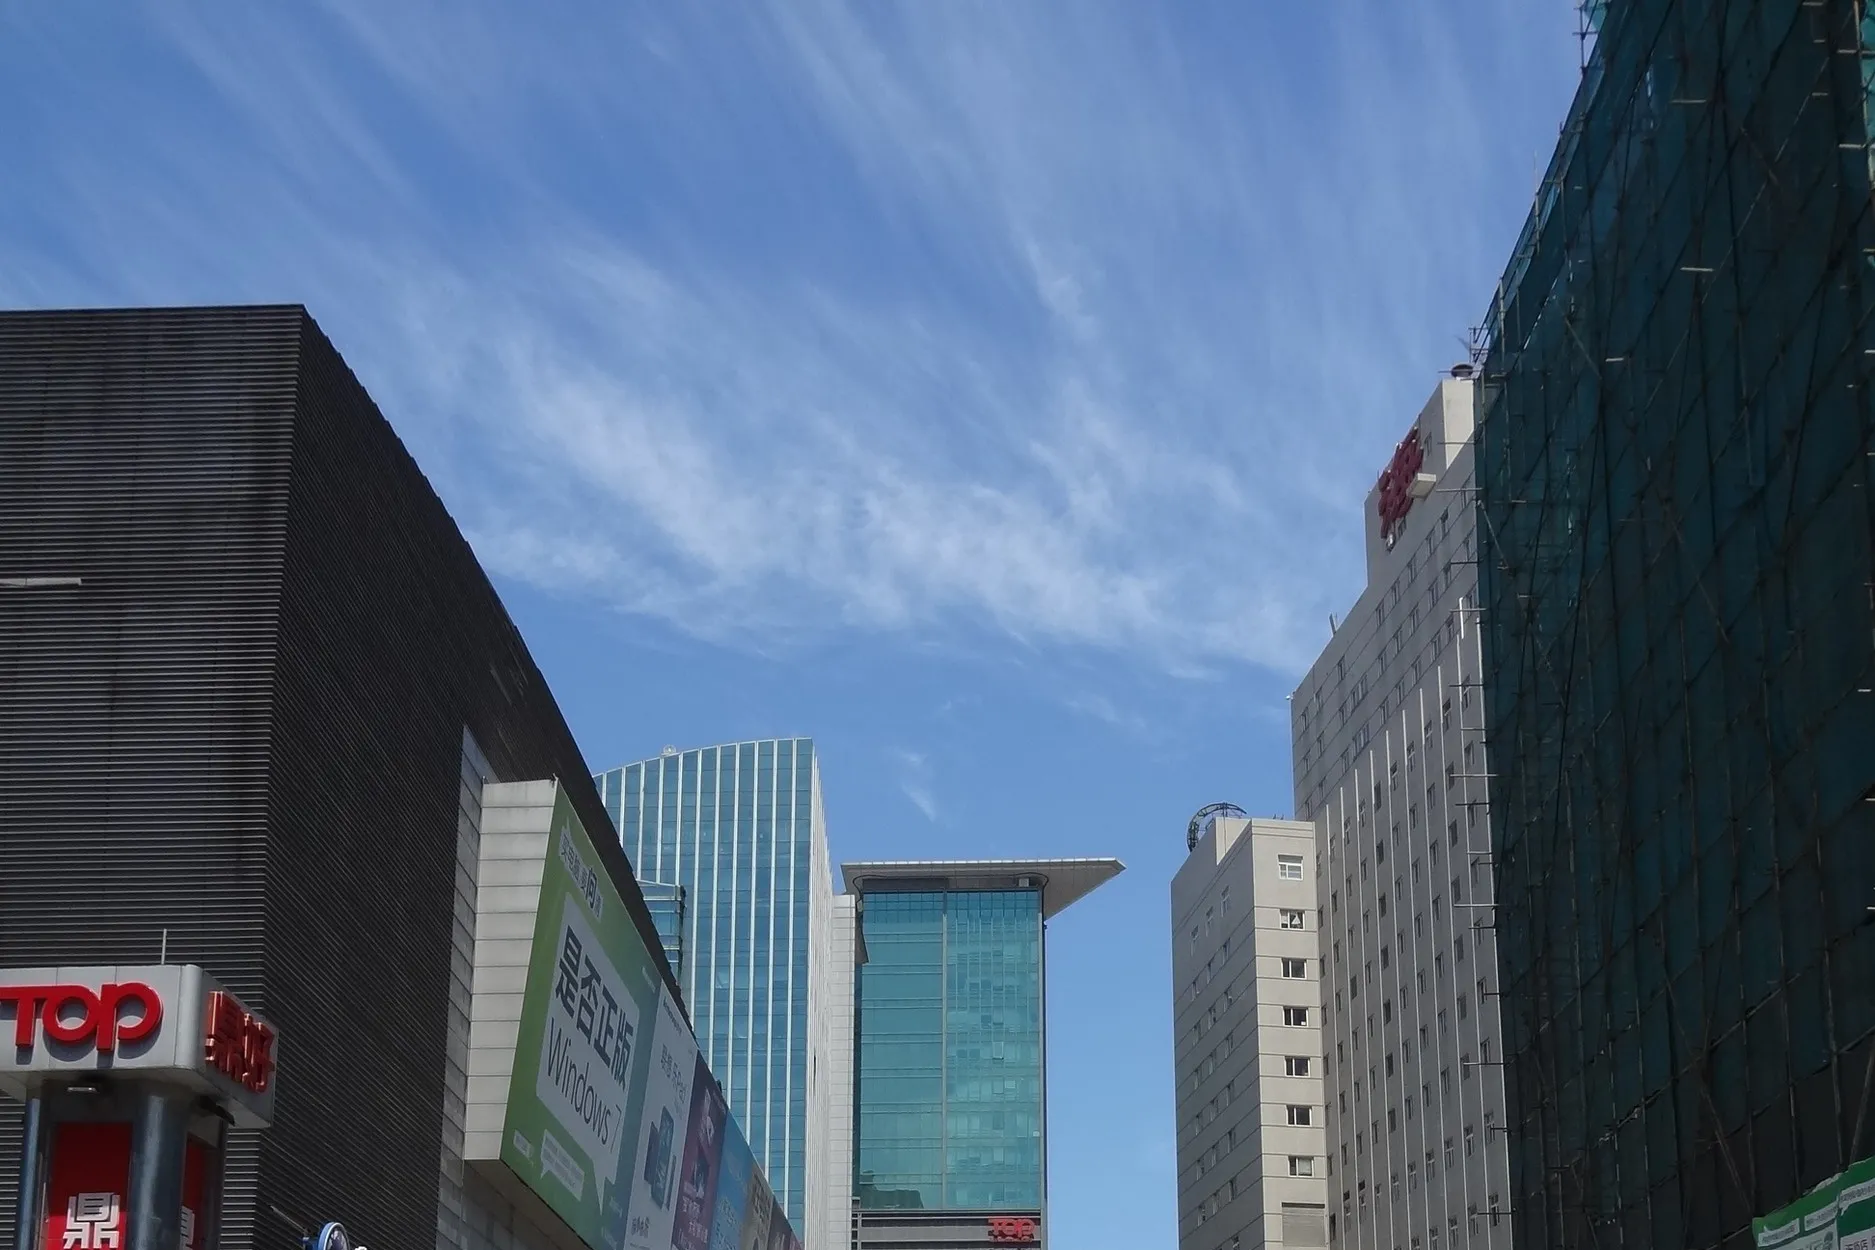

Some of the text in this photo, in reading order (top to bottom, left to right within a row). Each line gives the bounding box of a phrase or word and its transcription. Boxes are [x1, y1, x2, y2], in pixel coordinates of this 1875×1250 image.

[0, 982, 163, 1051] TOP
[554, 924, 635, 1091] 是否正版
[547, 1016, 610, 1146] Windows
[987, 1217, 1035, 1238] TOP
